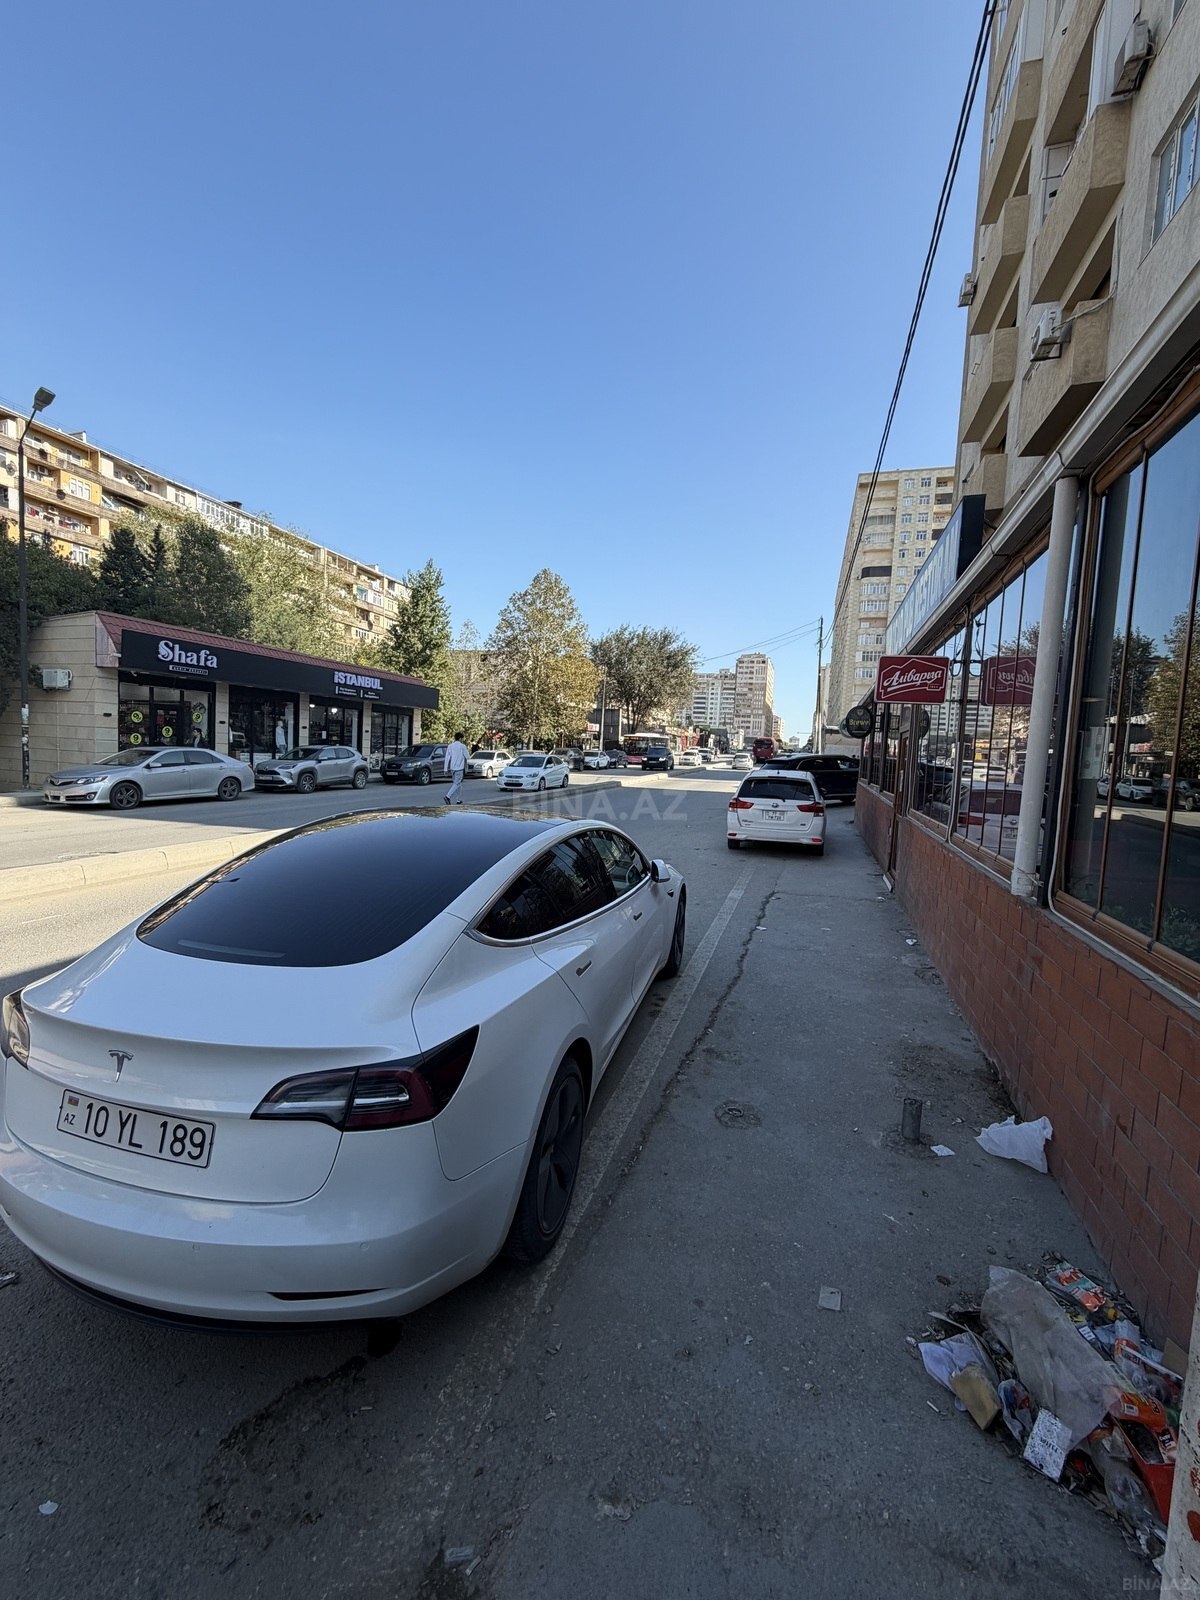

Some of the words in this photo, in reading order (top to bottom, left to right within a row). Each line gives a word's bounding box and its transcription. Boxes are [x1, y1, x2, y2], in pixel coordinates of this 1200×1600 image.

[158, 640, 218, 668] Shafa
[63, 1112, 76, 1126] AZ
[84, 1102, 110, 1138] 10
[118, 1109, 143, 1149] YL
[158, 1120, 207, 1160] 189
